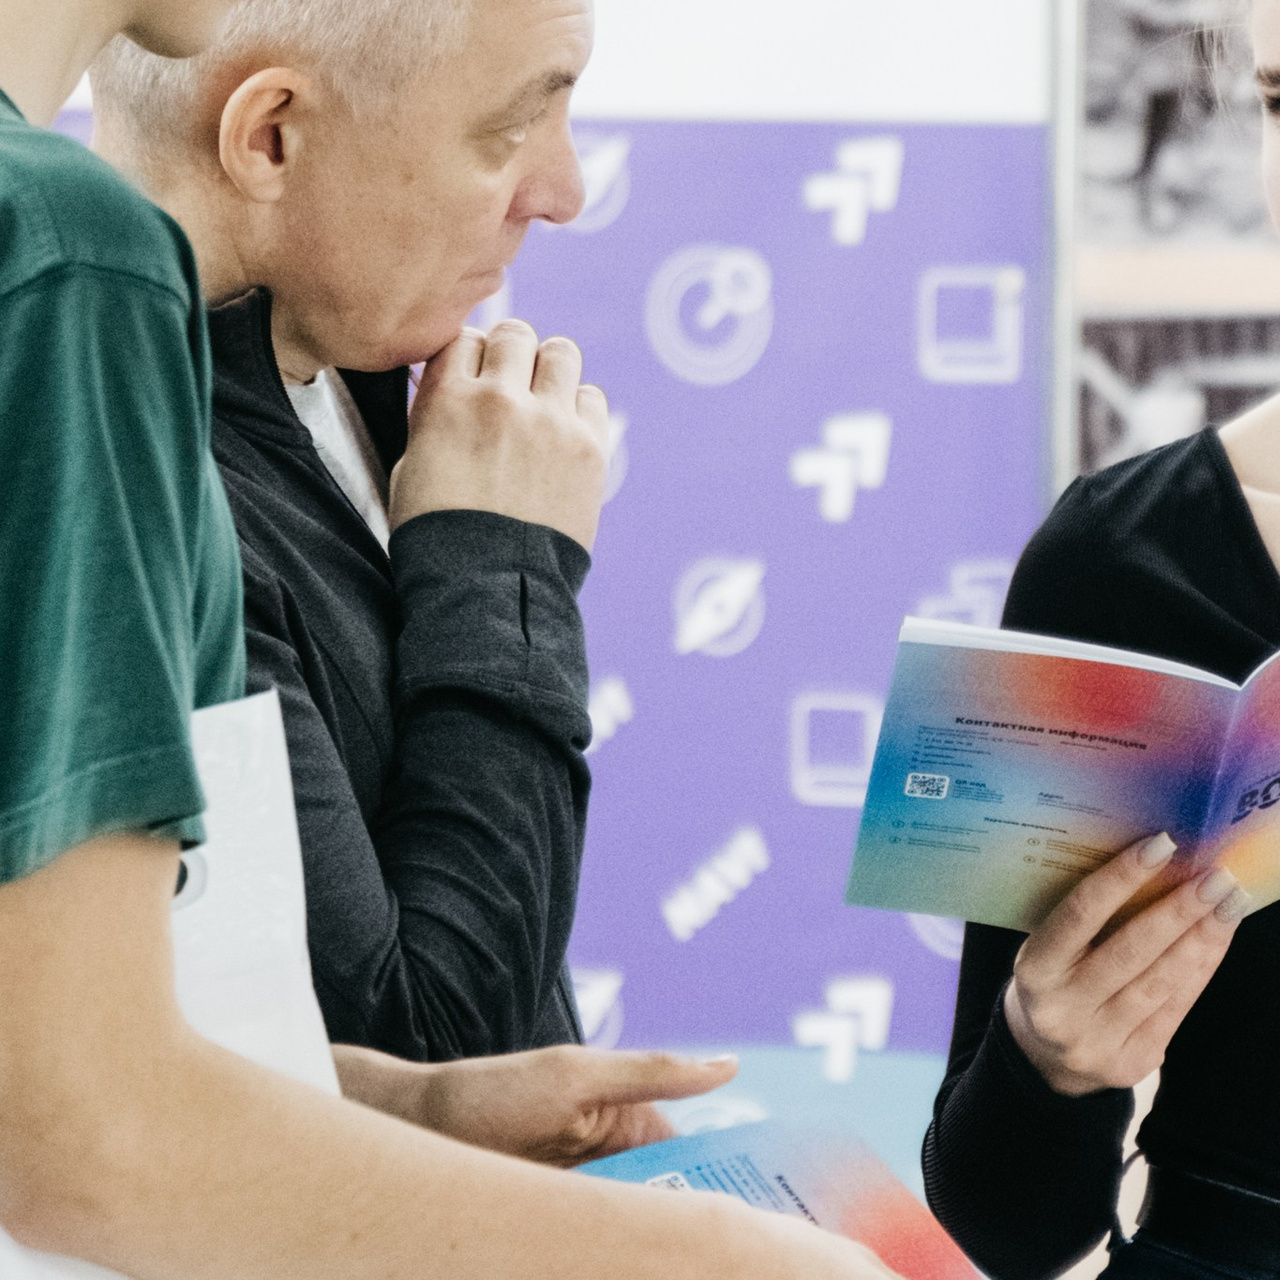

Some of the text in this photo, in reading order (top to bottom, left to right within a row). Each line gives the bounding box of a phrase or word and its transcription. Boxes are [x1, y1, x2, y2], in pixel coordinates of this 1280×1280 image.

[955, 716, 1044, 734] Контактная
[1048, 728, 1148, 751] информация
[774, 1173, 820, 1226] Контакт
